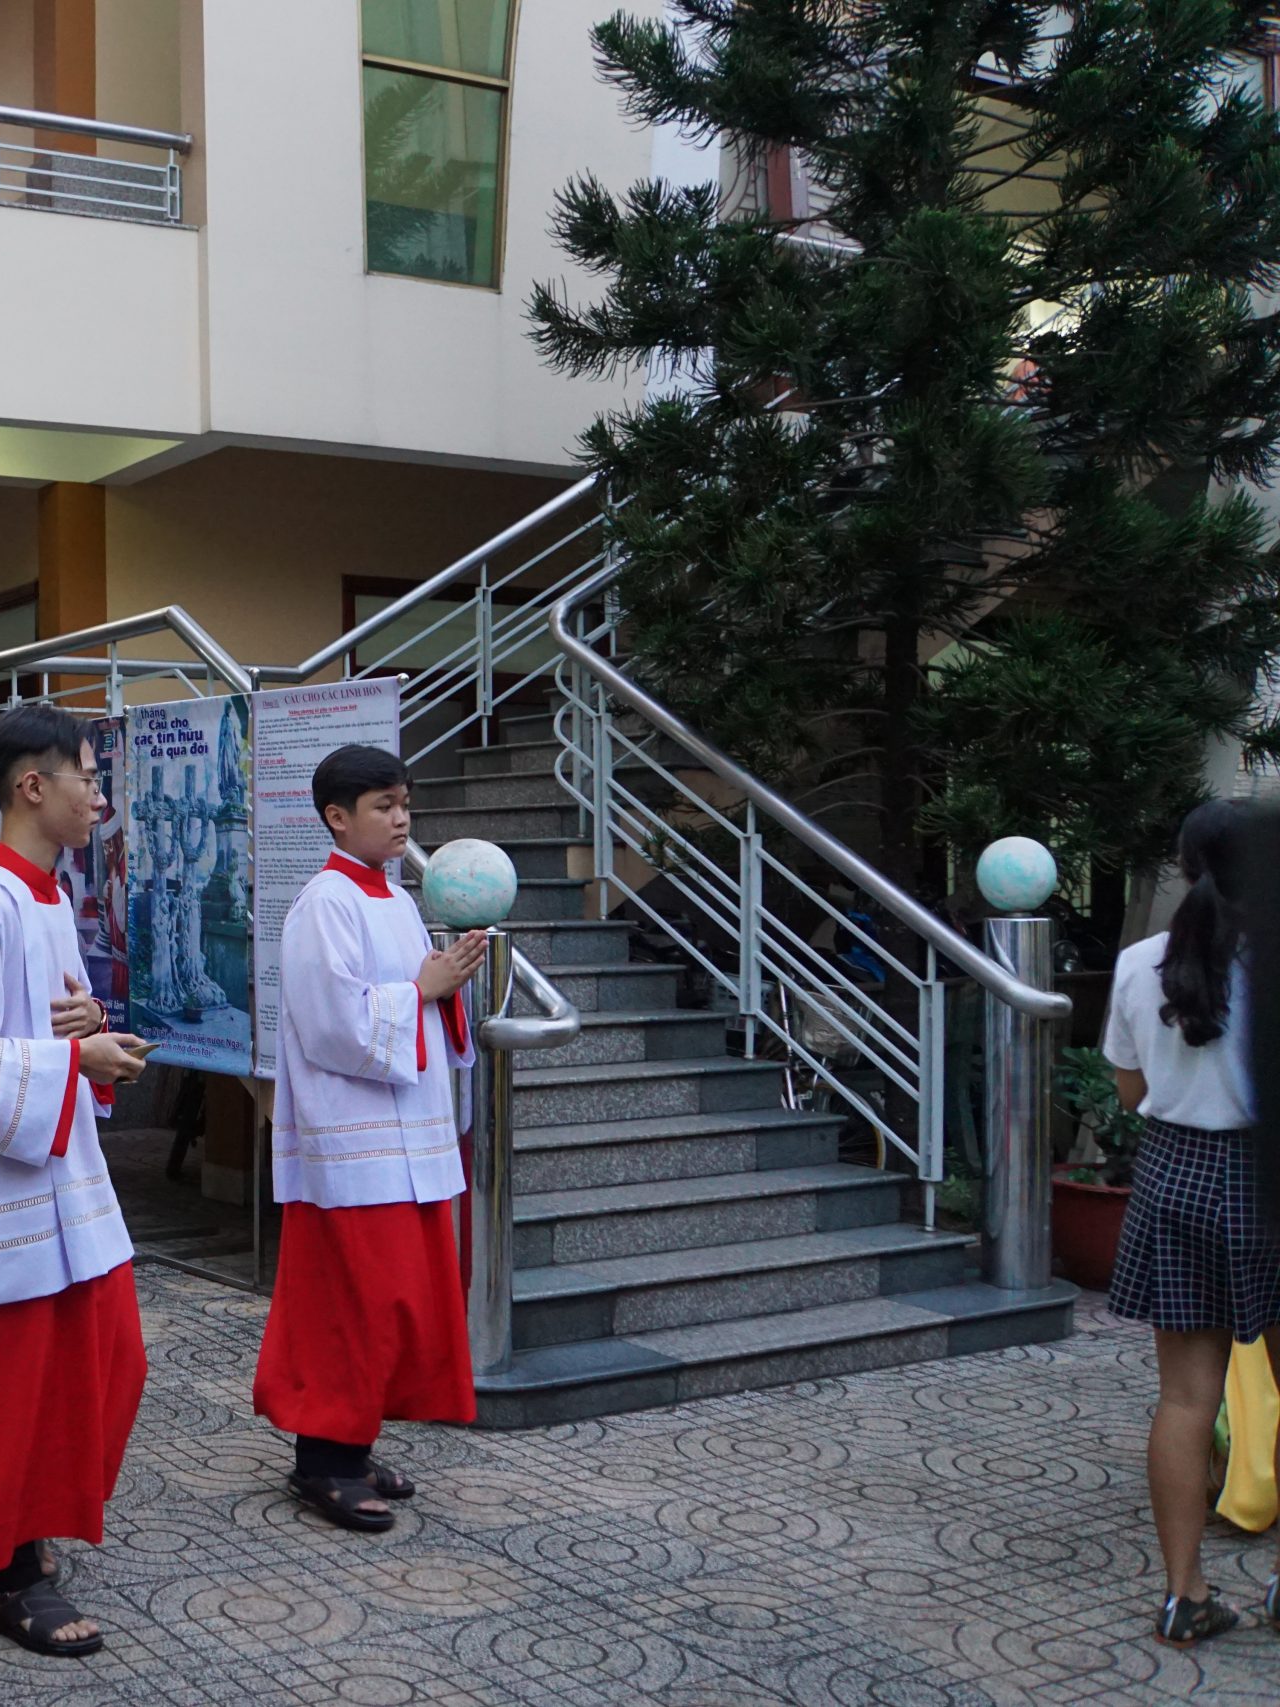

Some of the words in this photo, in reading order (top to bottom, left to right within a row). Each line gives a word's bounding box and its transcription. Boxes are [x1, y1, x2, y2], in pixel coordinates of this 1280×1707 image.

[302, 692, 321, 703] CHO
[340, 687, 362, 699] LINH
[140, 708, 166, 720] tháng
[170, 717, 189, 729] cho
[166, 746, 187, 760] qua
